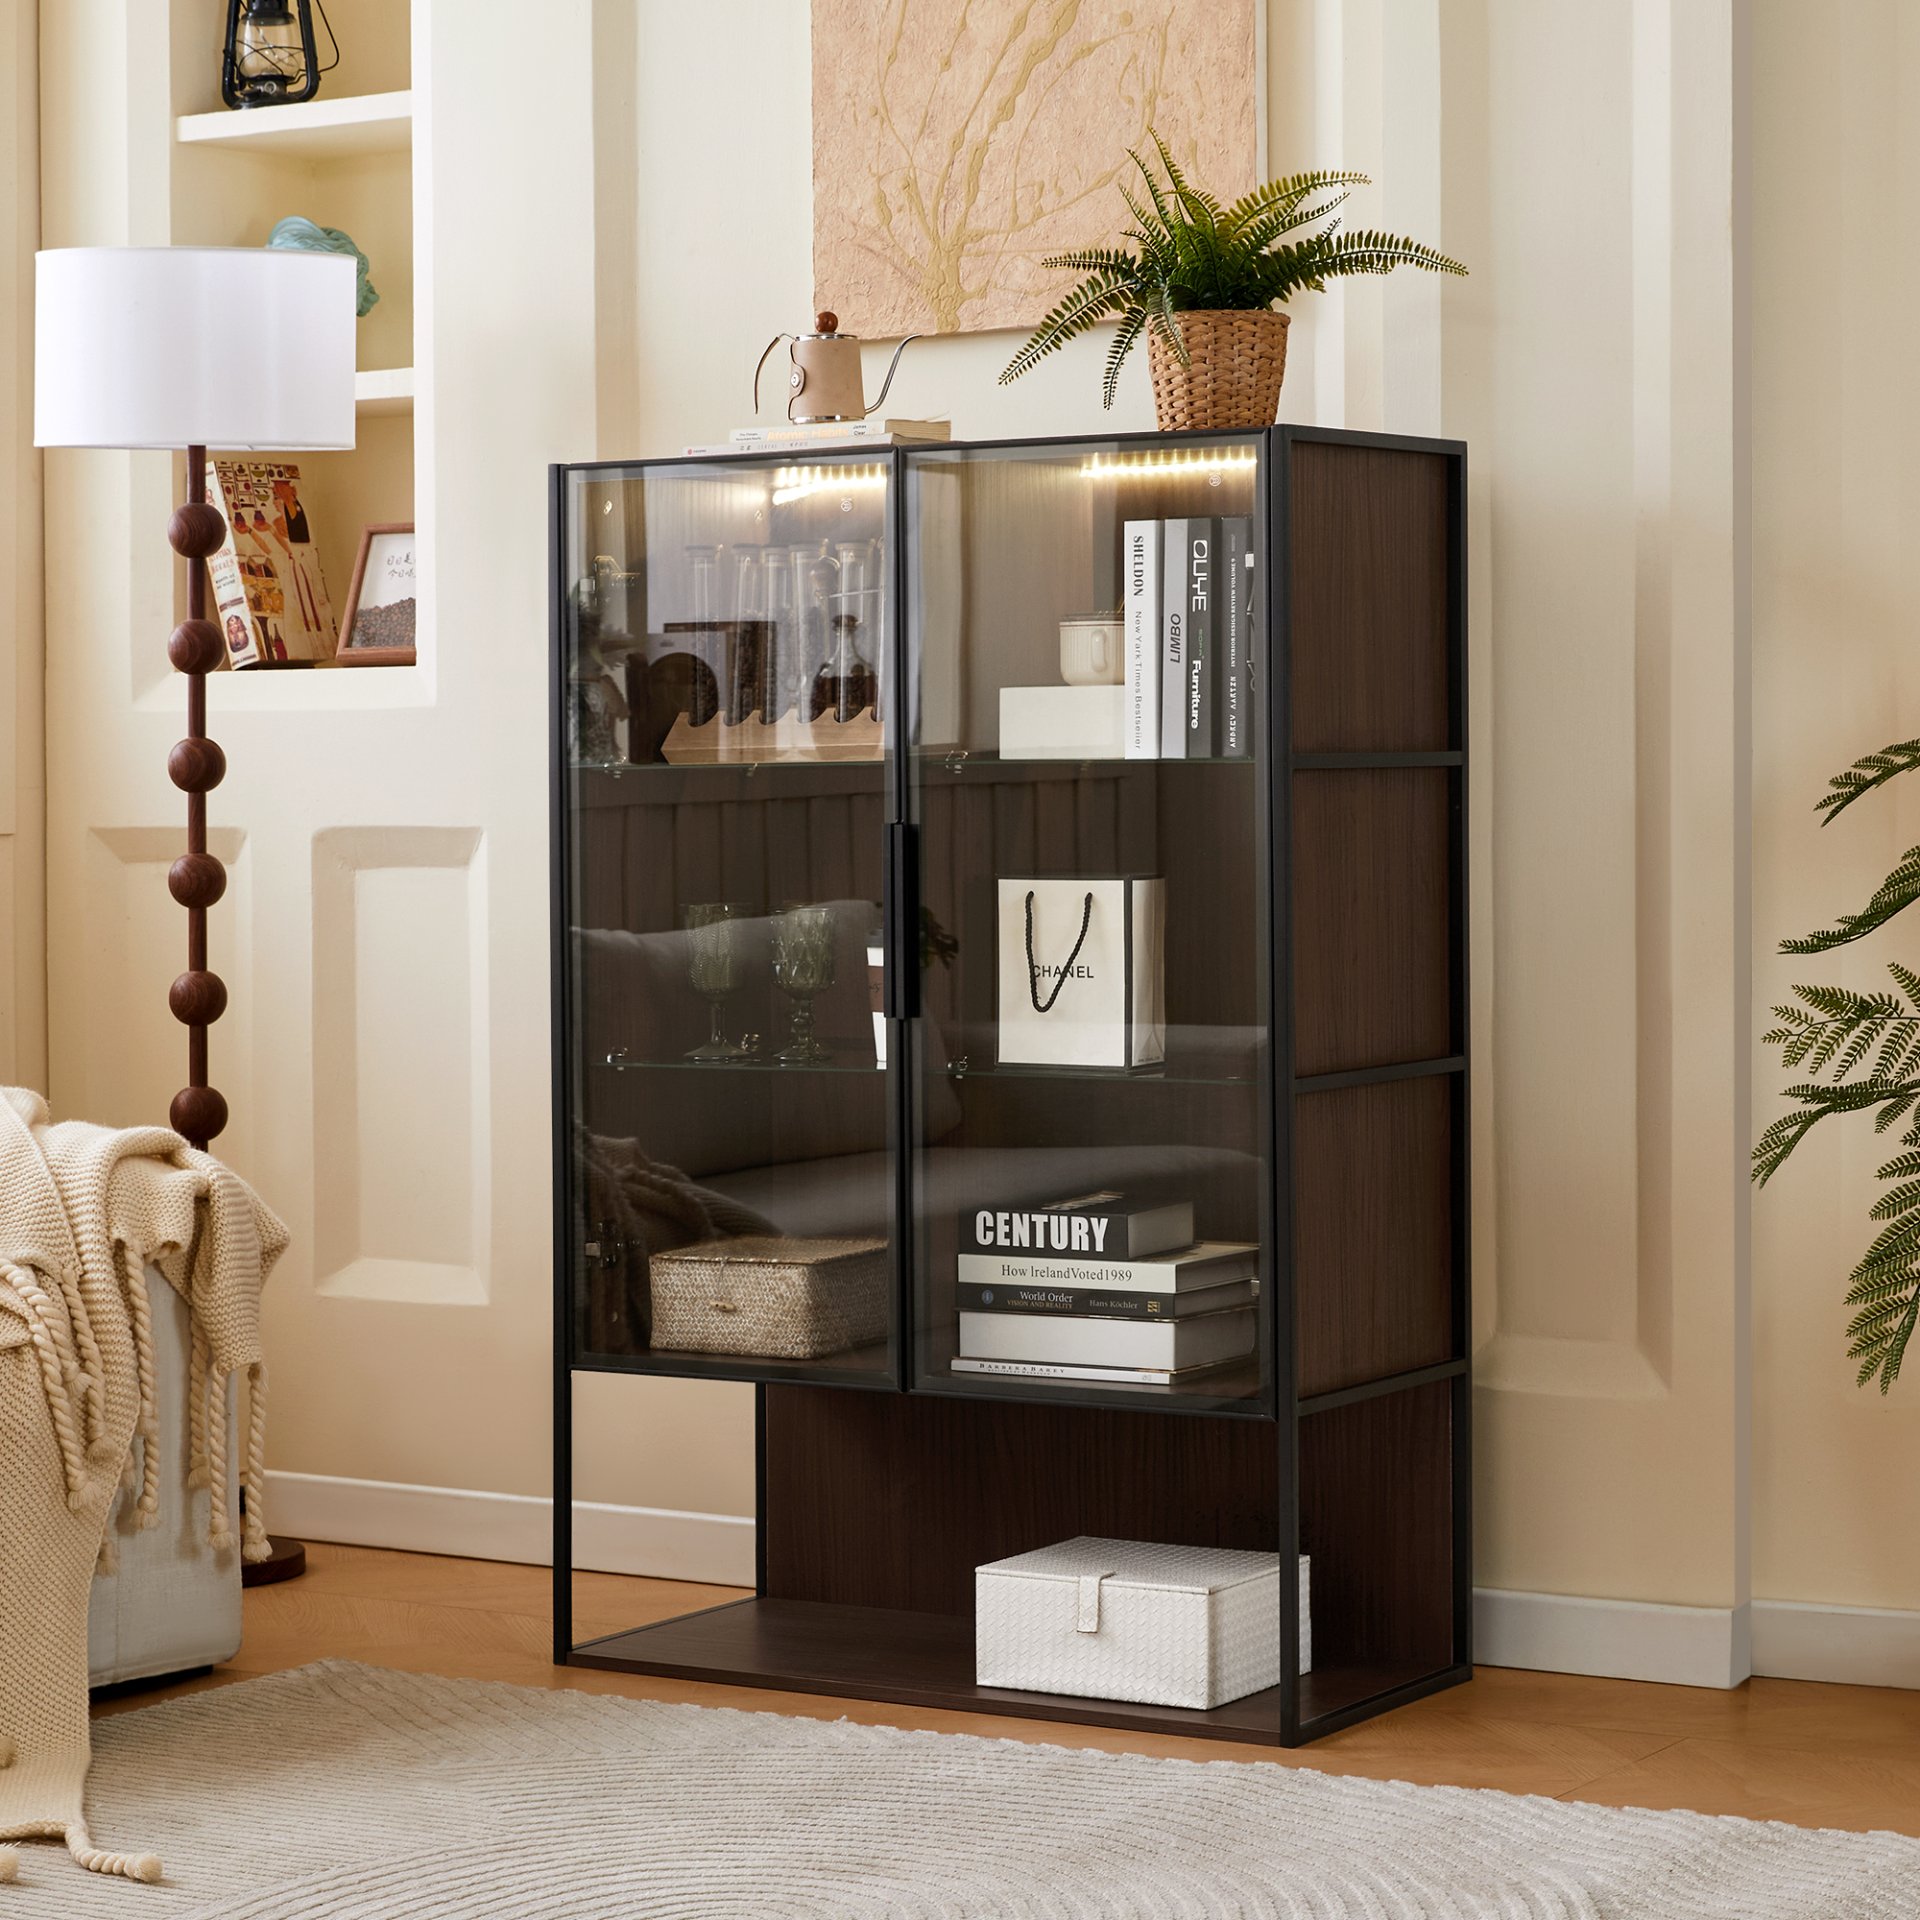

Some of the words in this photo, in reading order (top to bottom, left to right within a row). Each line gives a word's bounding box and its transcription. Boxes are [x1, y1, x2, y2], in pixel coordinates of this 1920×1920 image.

[1133, 535, 1144, 597] SHELDON
[1170, 613, 1182, 664] LIMBO
[1191, 659, 1202, 730] Furniture
[1032, 965, 1094, 978] CHANEL
[975, 1210, 1109, 1252] CENTURY
[1001, 1264, 1028, 1276] How
[1019, 1291, 1045, 1301] World
[1048, 1292, 1074, 1303] Order
[1089, 1299, 1108, 1307] Hans
[1029, 1300, 1045, 1308] AND
[1045, 1301, 1073, 1309] REALITY
